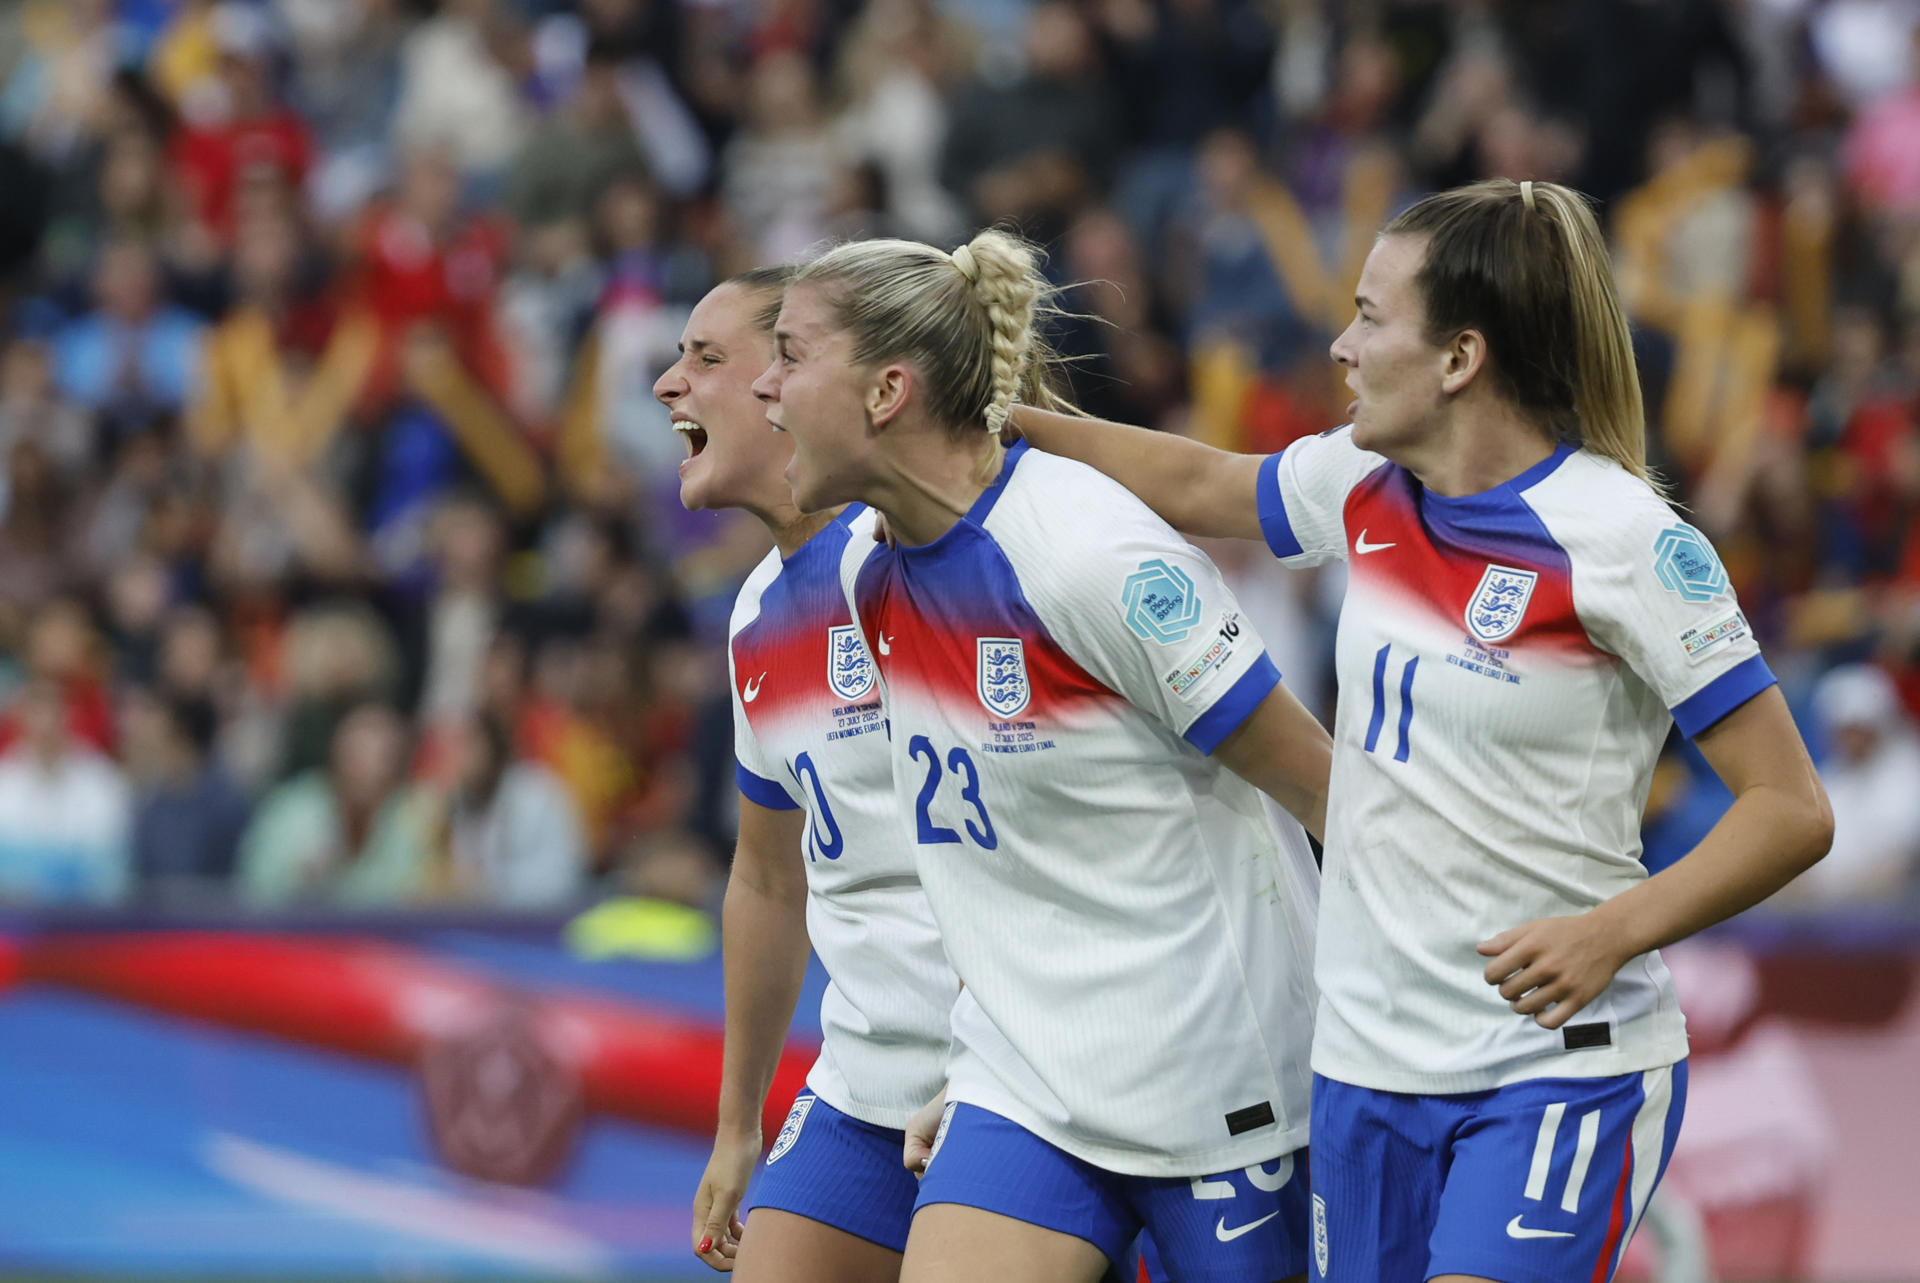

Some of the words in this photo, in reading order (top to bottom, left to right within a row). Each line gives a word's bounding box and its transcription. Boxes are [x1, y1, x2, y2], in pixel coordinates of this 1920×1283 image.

[1173, 640, 1226, 693] FOUNDATION
[1165, 669, 1181, 684] UEFA
[1483, 667, 1501, 680] EURO
[1501, 672, 1520, 685] FINAL
[832, 705, 856, 717] ENGLAND
[1364, 642, 1420, 764] 11
[838, 719, 845, 728] 27
[846, 715, 860, 726] JULY
[862, 711, 879, 722] 2025
[826, 731, 839, 741] UEFA
[864, 722, 880, 733] EURO
[1017, 732, 1034, 743] 2025
[1019, 743, 1036, 753] EURO
[1037, 740, 1056, 751] FINAL
[908, 734, 998, 851] 23
[1523, 1102, 1601, 1214] 11
